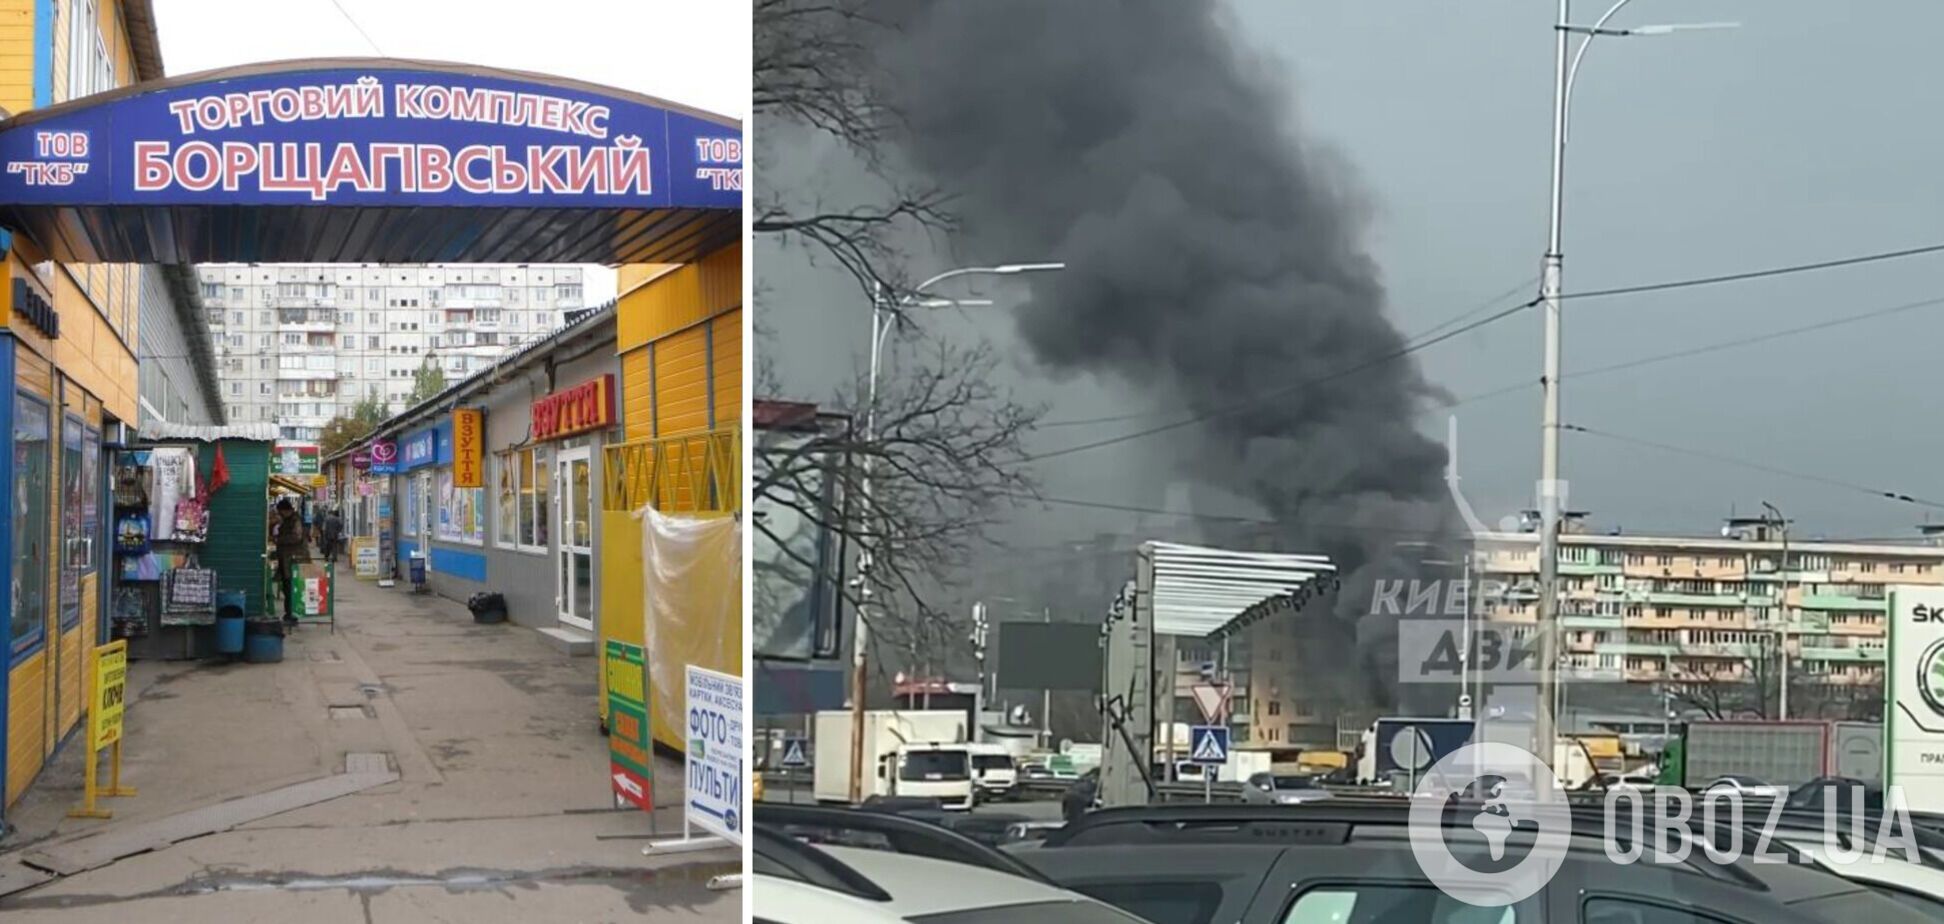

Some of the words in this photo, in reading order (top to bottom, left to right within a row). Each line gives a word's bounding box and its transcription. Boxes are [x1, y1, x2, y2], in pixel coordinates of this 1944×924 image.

[169, 76, 384, 134] ТОРГОВИЙ
[395, 84, 610, 139] КОМПЛЕКС
[37, 132, 88, 157] ТОВ
[134, 135, 652, 200] БОРЩАГІВСЬКИЙ
[696, 138, 741, 162] ТОВ
[696, 168, 742, 190] "ТК
[532, 381, 599, 438] ВЗУТТЯ
[461, 413, 474, 483] ВЗУТТЯ
[690, 707, 726, 744] ФОТО
[690, 760, 738, 807] ПУЛЬТИ
